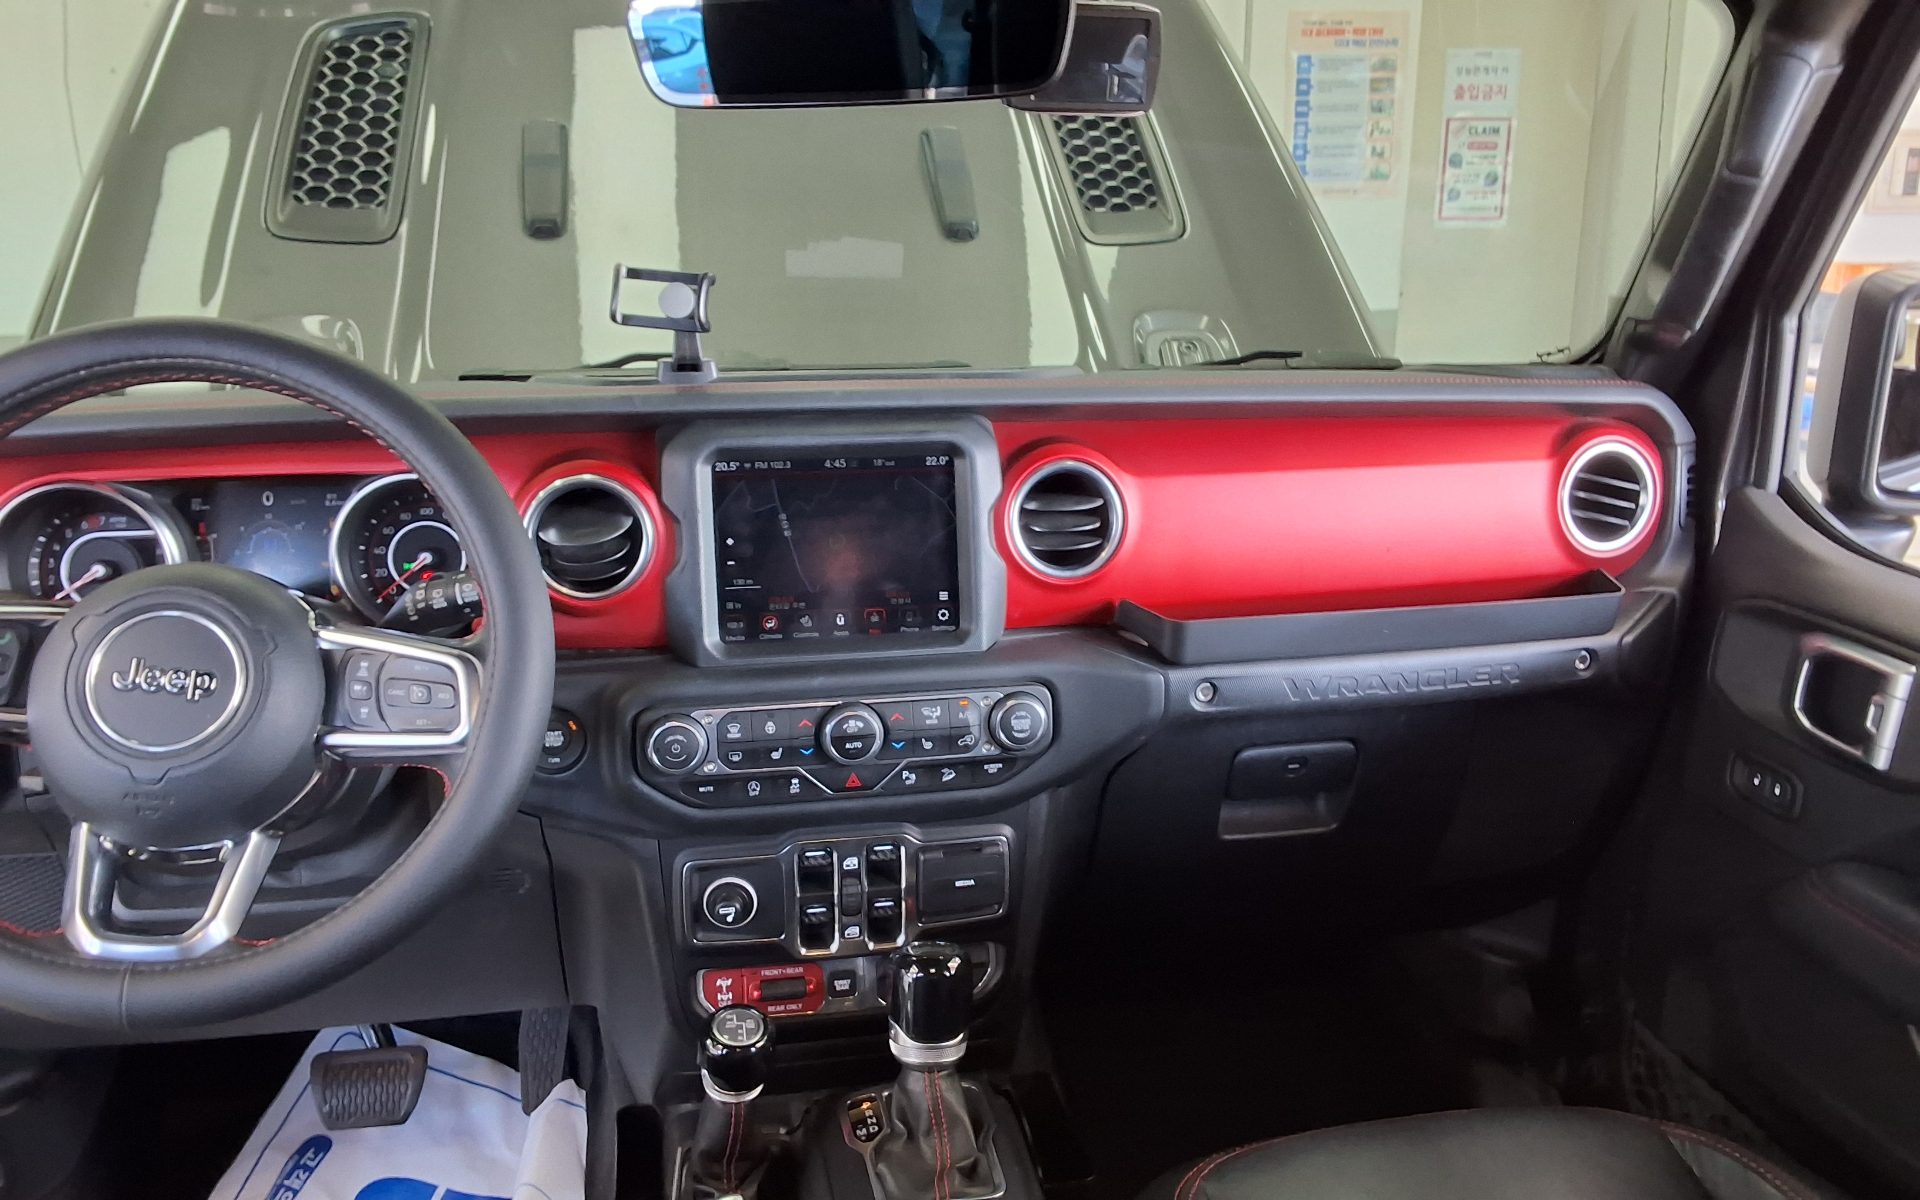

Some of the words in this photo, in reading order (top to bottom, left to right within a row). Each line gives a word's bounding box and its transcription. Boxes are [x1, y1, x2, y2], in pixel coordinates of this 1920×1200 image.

[1454, 84, 1508, 101] 출입금지
[1468, 126, 1500, 136] CLAIM
[824, 458, 847, 468] 4:45
[419, 508, 434, 516] 100
[382, 526, 395, 535] 60
[375, 567, 388, 577] 20
[112, 657, 217, 702] Jeep
[1283, 662, 1520, 701] WRANGLER
[845, 741, 863, 749] AUTO
[768, 1004, 786, 1012] REAR
[786, 1003, 803, 1011] ONLY
[867, 1116, 877, 1124] N
[856, 1128, 867, 1136] M
[869, 1125, 879, 1133] D
